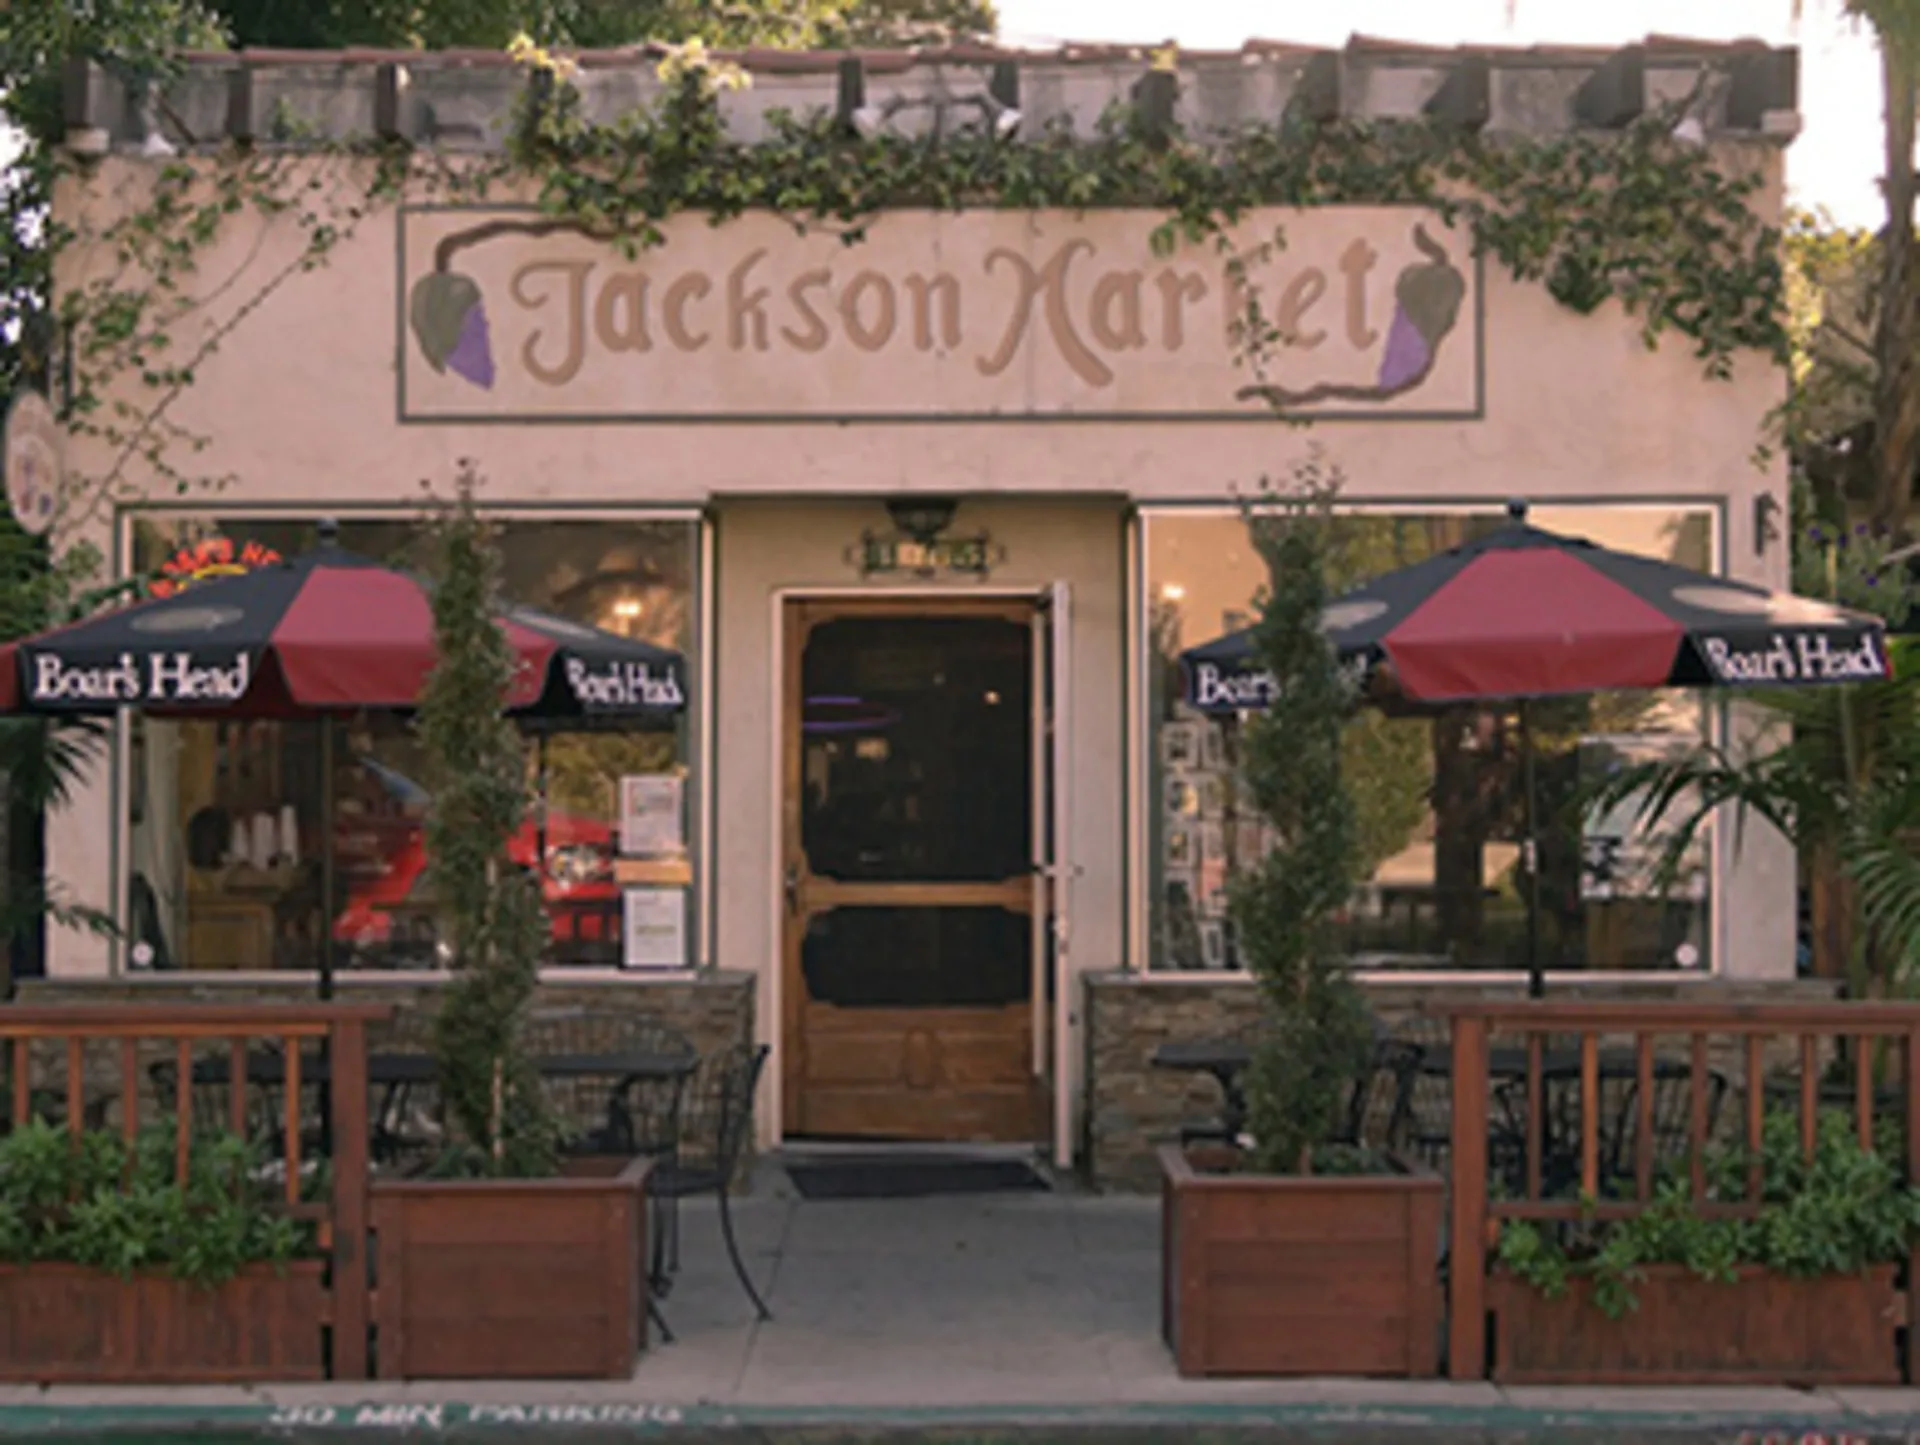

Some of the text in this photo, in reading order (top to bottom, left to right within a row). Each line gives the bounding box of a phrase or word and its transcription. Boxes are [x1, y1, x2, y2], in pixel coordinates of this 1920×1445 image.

[509, 247, 962, 387] Jackson
[34, 652, 249, 700] Boar's Head
[1703, 632, 1885, 680] Boar's Head
